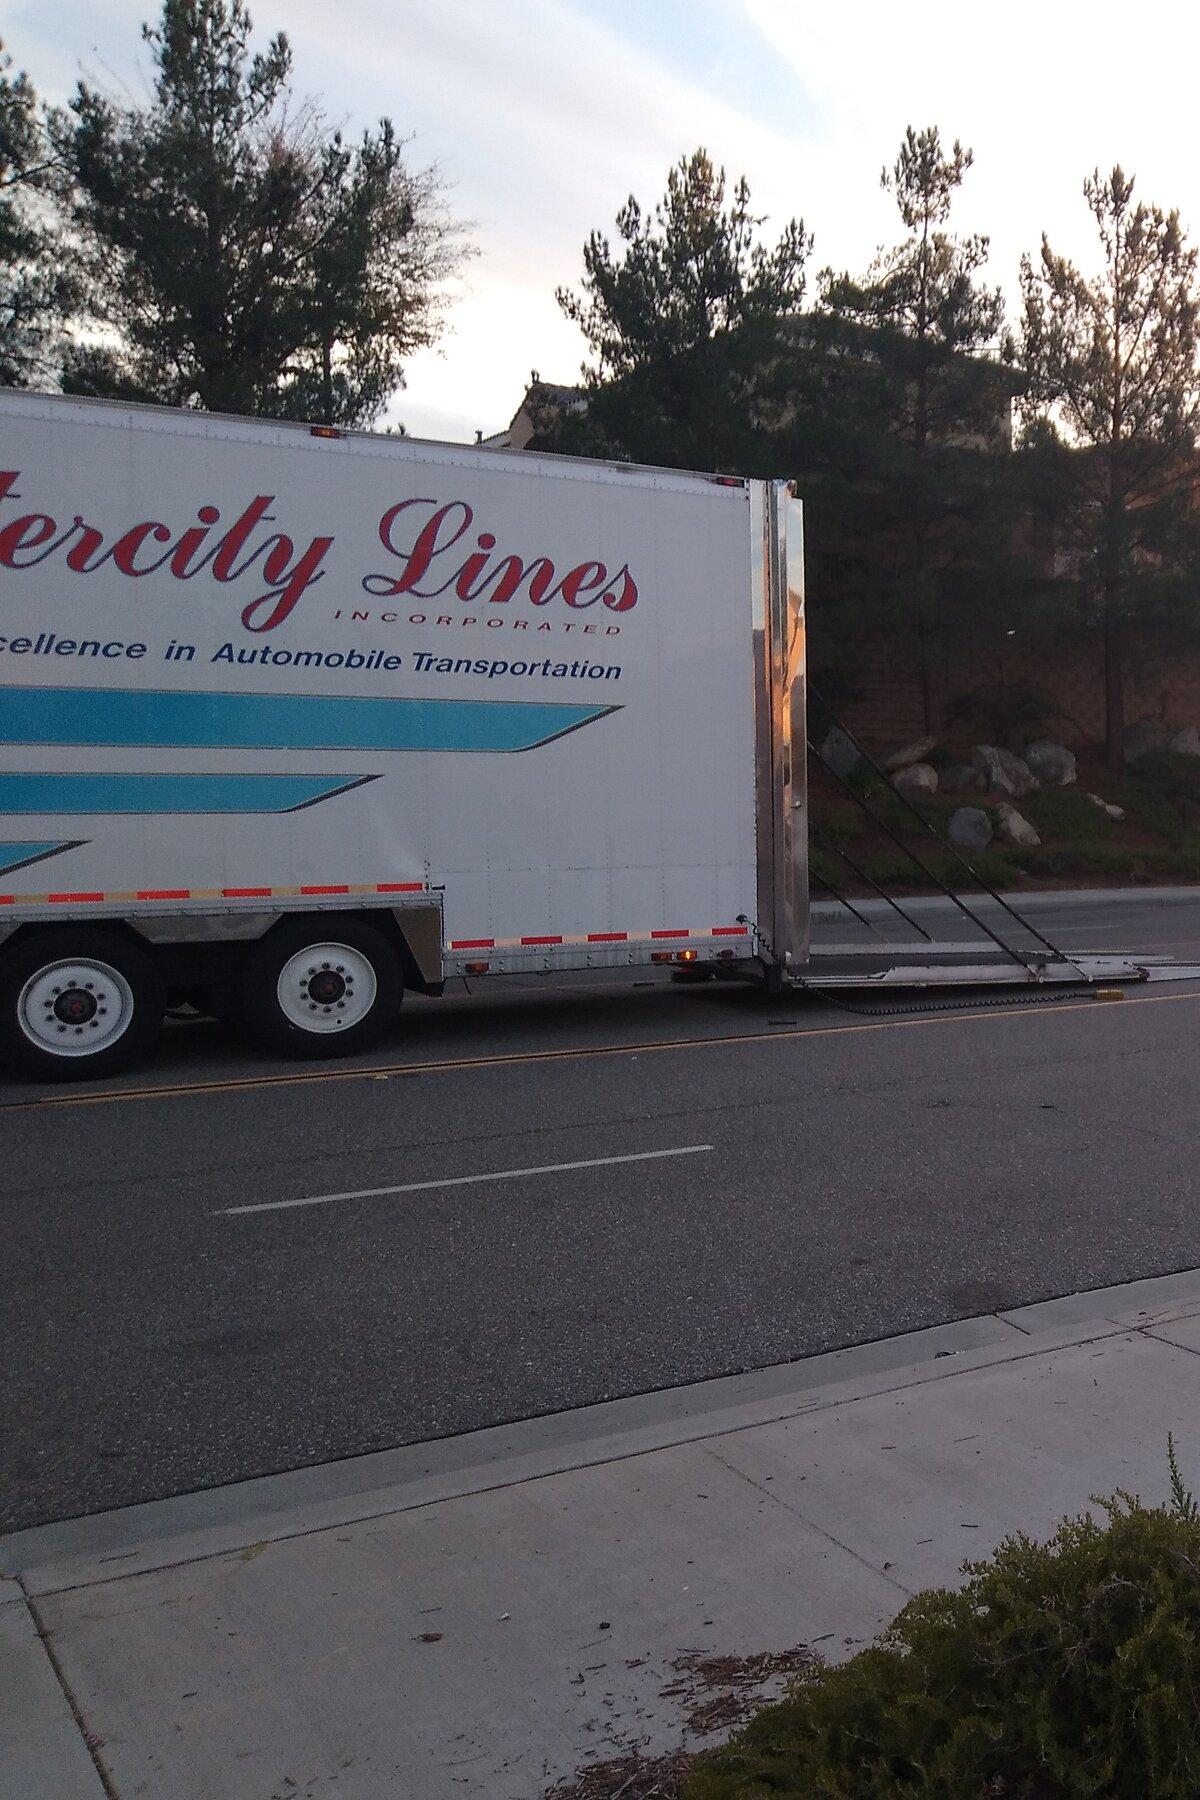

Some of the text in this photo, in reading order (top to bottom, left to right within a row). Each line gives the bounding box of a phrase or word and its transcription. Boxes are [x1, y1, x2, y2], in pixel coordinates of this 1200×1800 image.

[0, 470, 638, 633] ercity Lines
[334, 609, 621, 635] INCORPORATED
[164, 640, 196, 662] in
[211, 642, 402, 670] Automobile
[411, 651, 623, 680] Transportation
